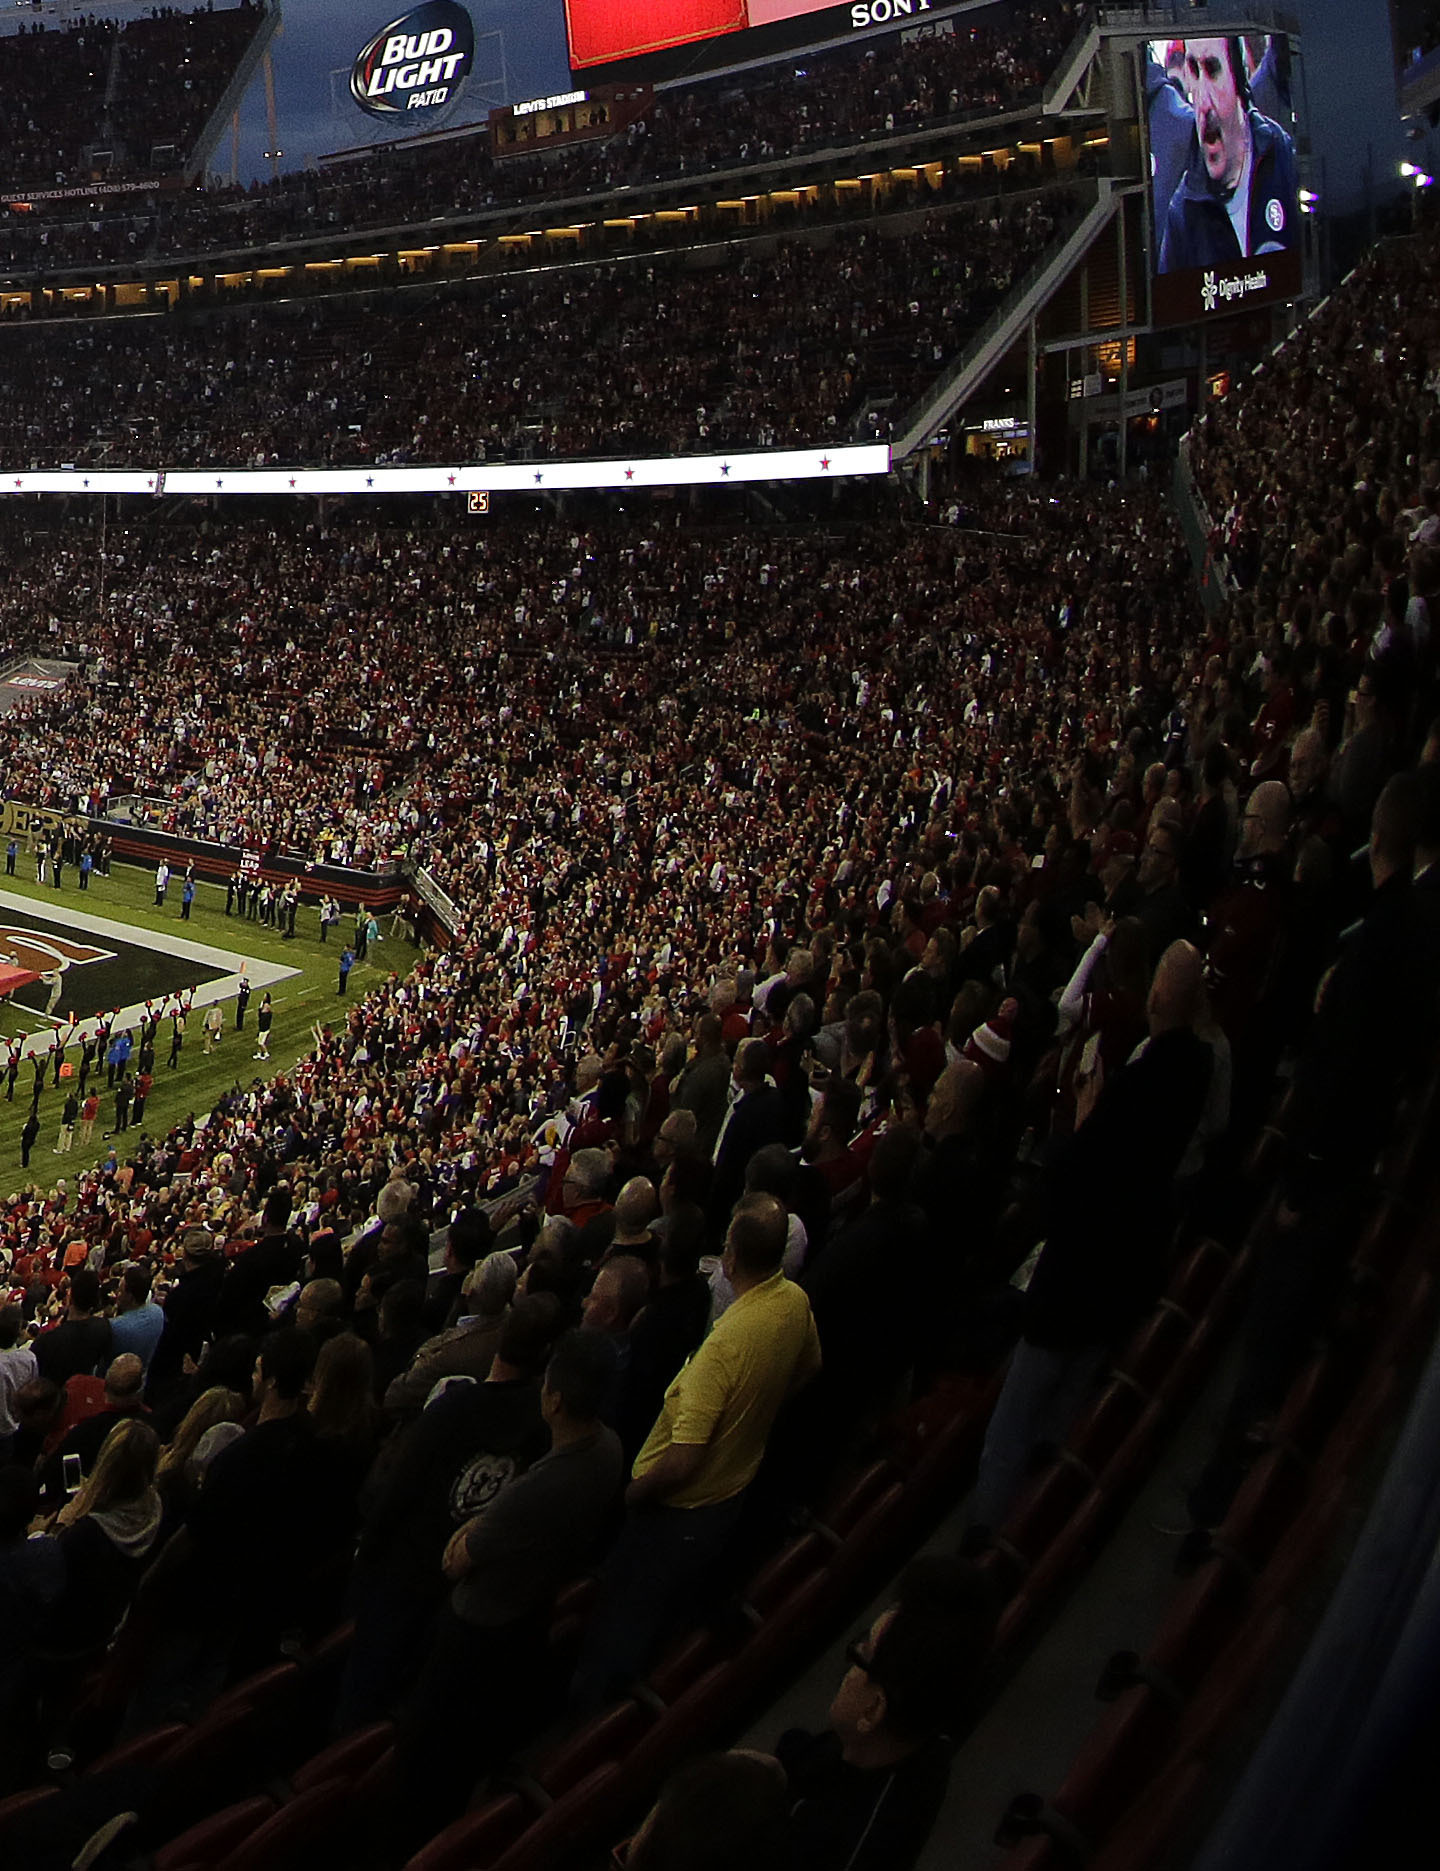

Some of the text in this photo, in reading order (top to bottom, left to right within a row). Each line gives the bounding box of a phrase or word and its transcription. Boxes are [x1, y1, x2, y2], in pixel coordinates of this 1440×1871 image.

[380, 27, 454, 67] BUD
[366, 52, 466, 98] LIGHT
[406, 86, 449, 111] PATIO
[26, 189, 65, 201] SERVICES
[64, 185, 99, 198] HOTLINE
[1219, 275, 1244, 301] Dignity
[470, 492, 487, 510] 25
